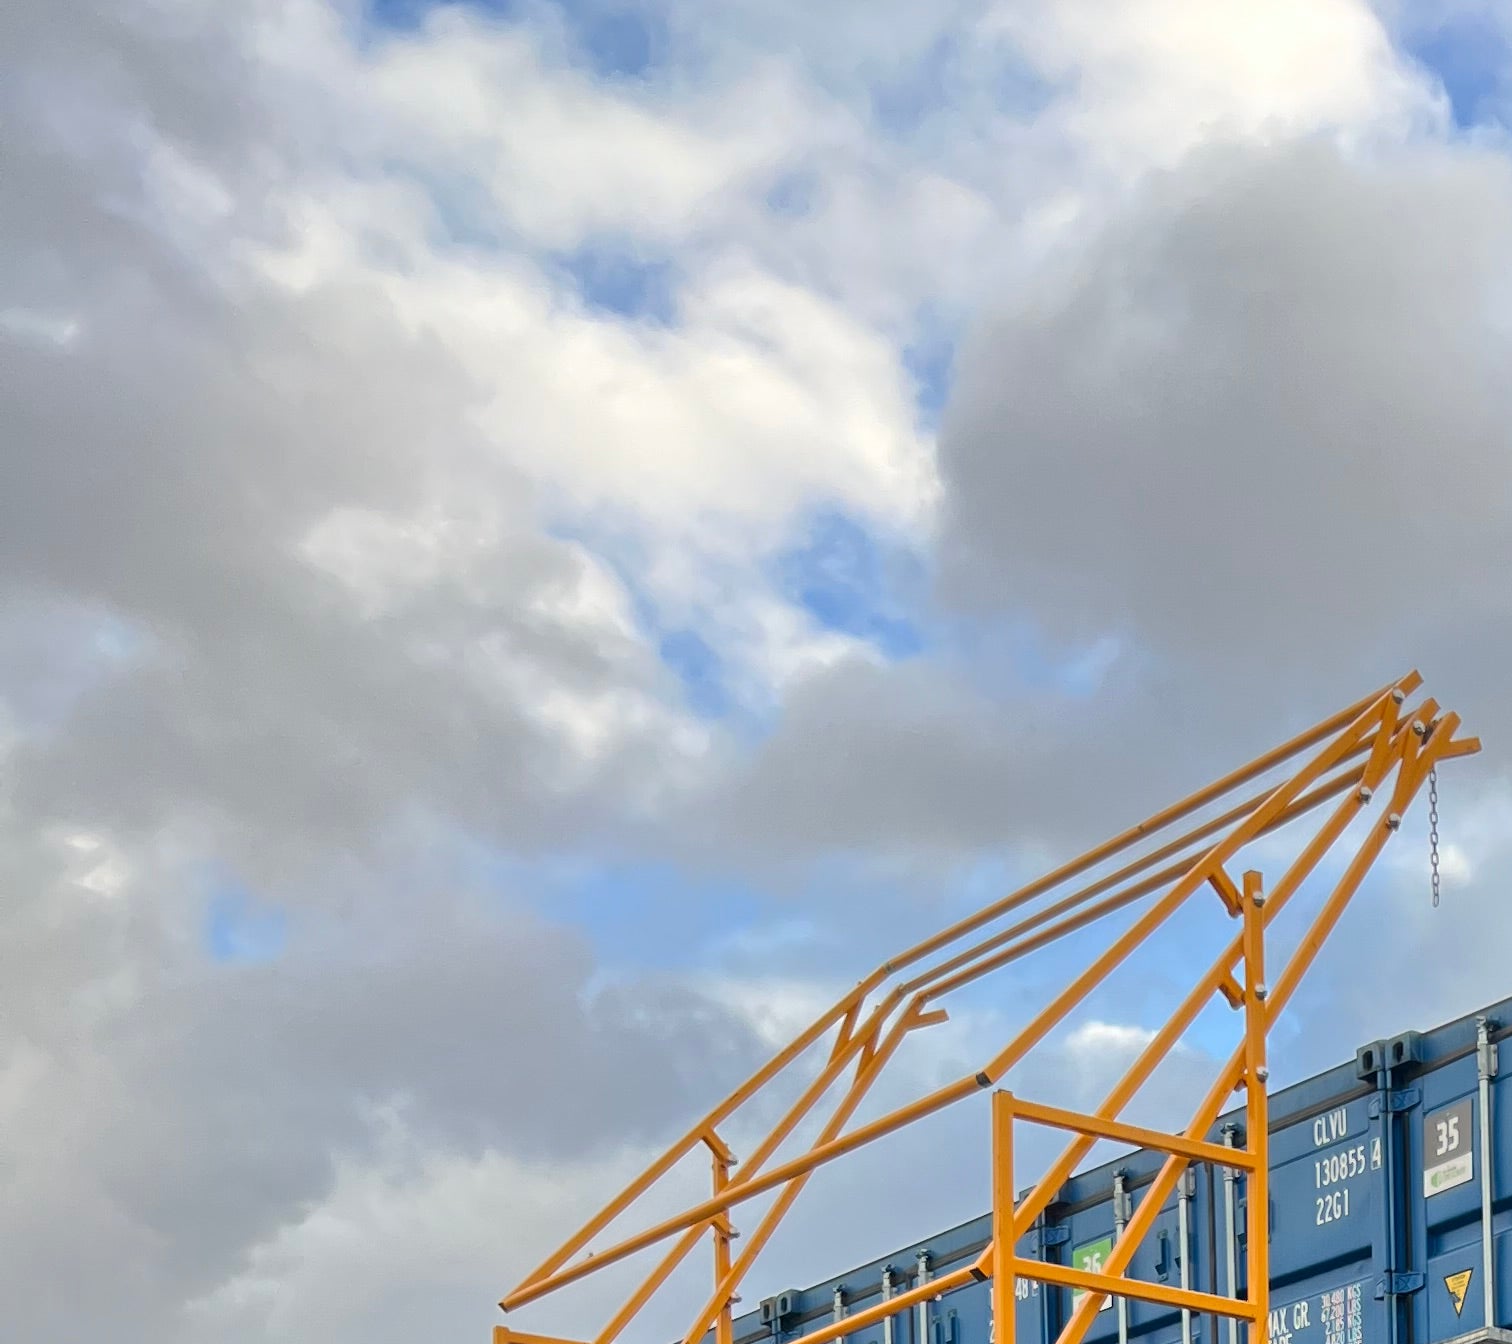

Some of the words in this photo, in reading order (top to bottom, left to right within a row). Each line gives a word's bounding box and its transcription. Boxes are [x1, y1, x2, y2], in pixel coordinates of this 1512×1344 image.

[1313, 1108, 1347, 1146] CLVU
[1437, 1116, 1459, 1156] 35
[1314, 1145, 1366, 1189] 130855
[1316, 1188, 1349, 1226] 22G1
